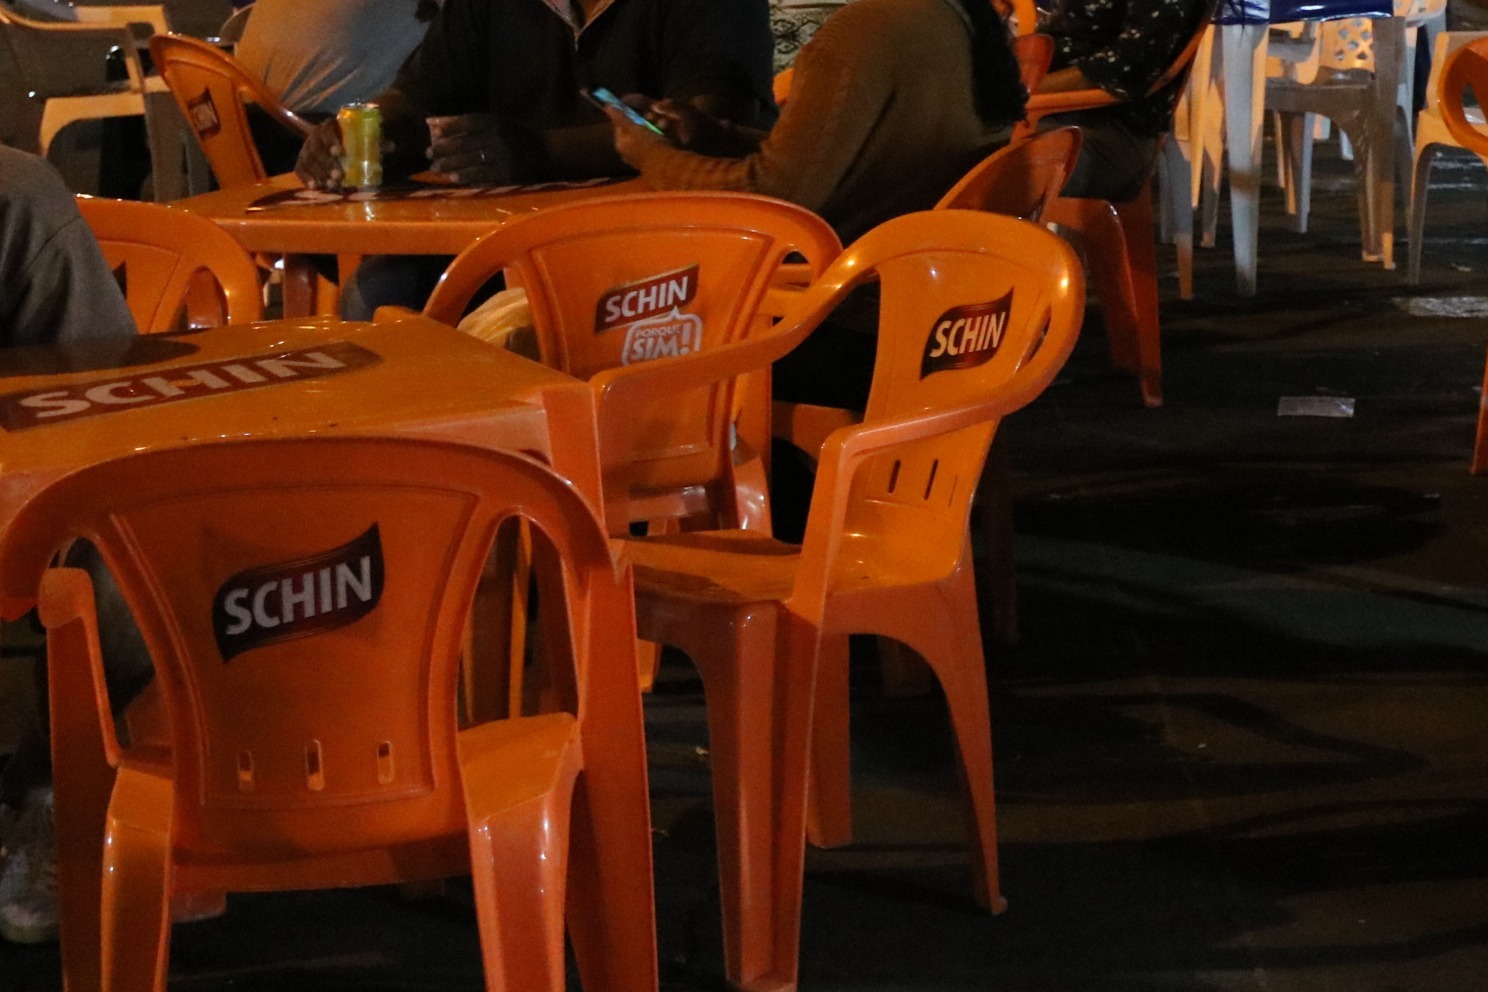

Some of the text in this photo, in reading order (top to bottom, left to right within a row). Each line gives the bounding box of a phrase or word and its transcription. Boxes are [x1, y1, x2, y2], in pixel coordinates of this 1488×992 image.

[604, 276, 689, 323] SCHIN
[631, 322, 689, 360] SIM!
[635, 323, 683, 339] PORQUE
[929, 311, 1007, 358] SCHIN
[18, 351, 348, 419] SCHIN
[224, 554, 375, 636] SCHIN
